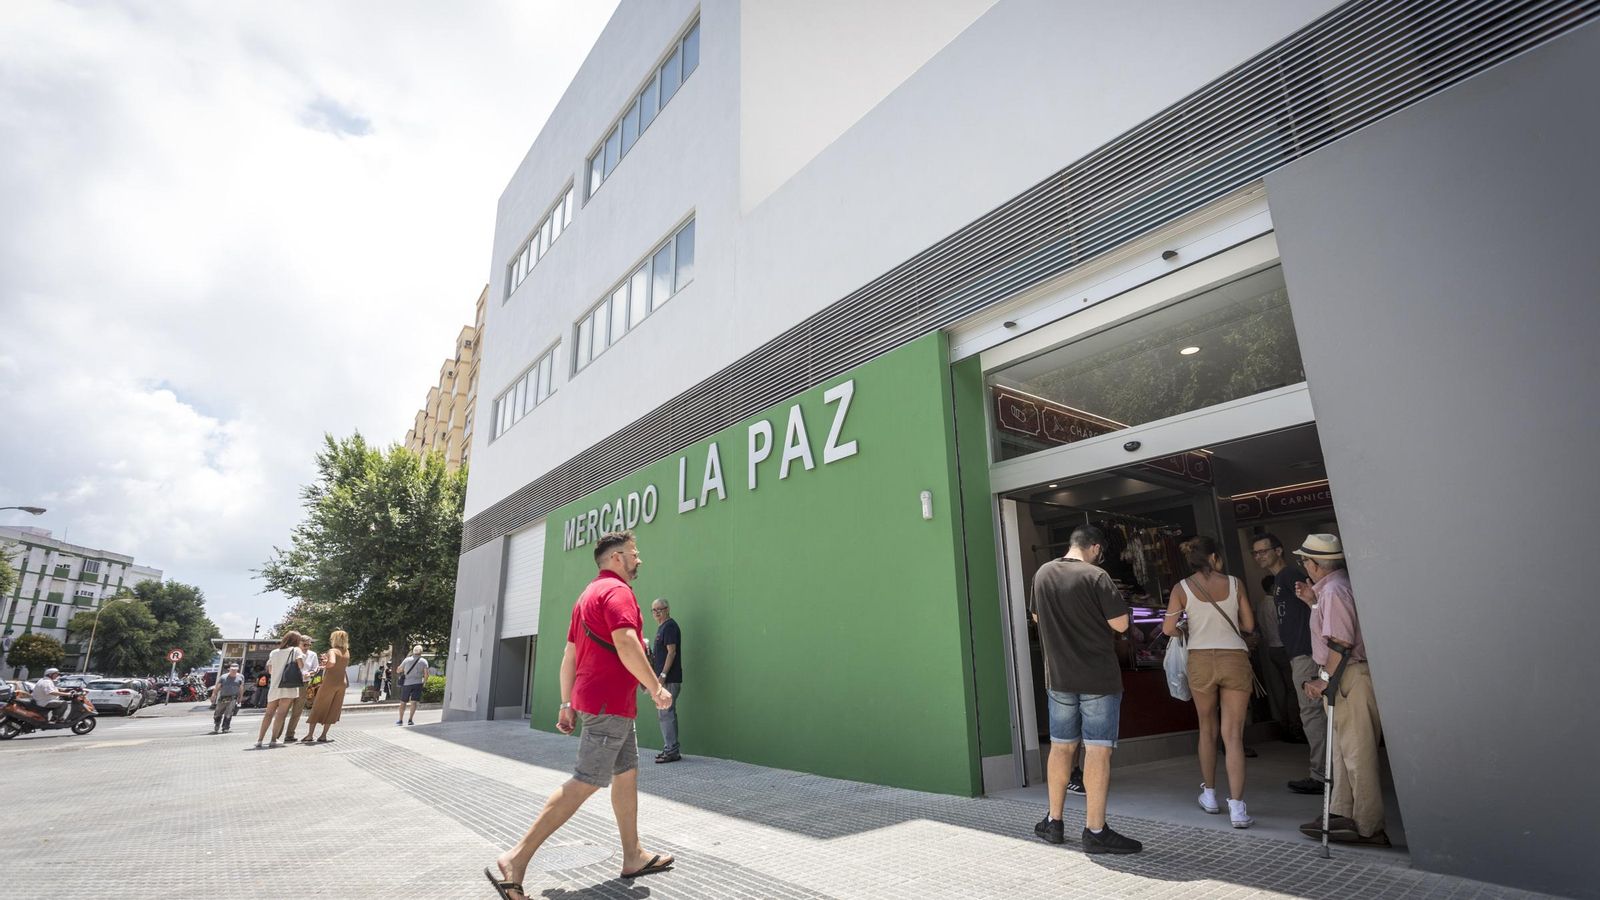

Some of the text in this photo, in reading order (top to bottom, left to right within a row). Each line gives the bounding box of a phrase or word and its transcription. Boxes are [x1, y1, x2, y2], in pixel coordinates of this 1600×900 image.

[563, 379, 859, 552] MERCADO LA PAZ
